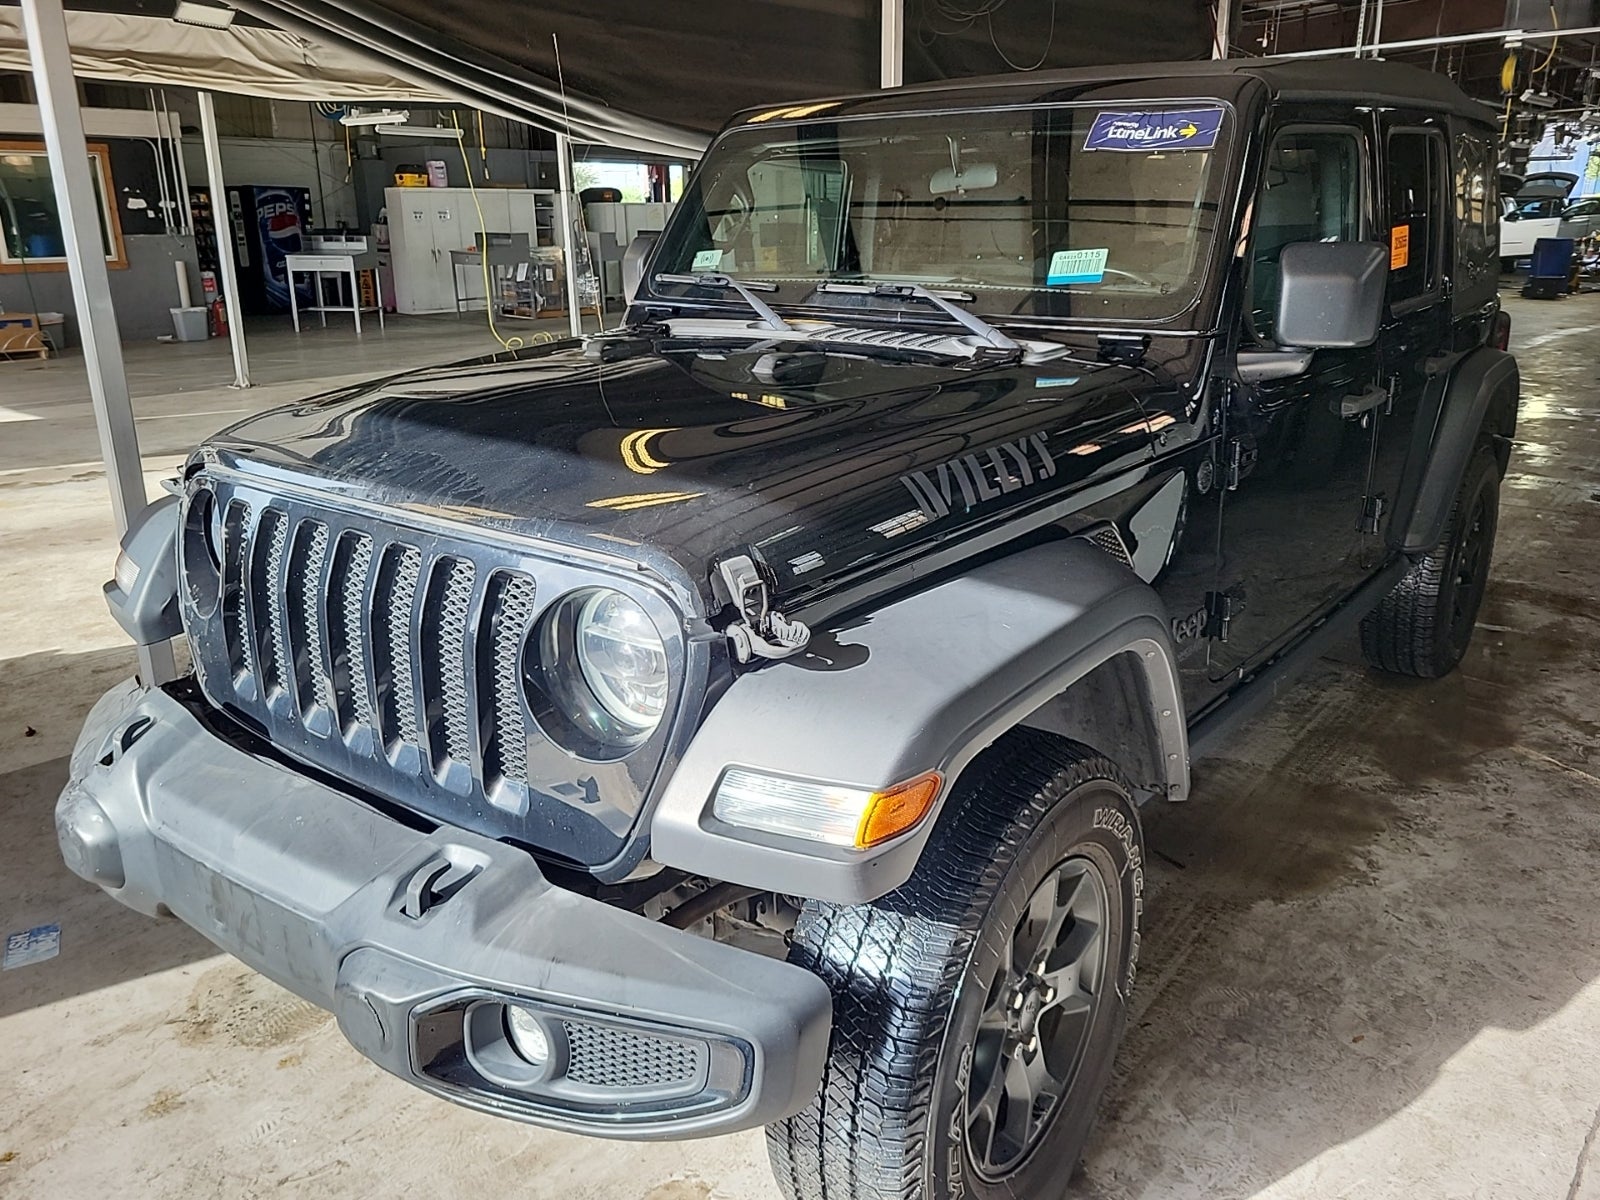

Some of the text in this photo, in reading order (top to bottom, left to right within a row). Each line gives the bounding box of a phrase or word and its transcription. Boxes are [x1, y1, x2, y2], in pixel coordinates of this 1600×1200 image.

[1107, 126, 1178, 140] LaneLink
[256, 203, 296, 223] PEPS
[899, 431, 1056, 521] WILLYS
[1093, 807, 1144, 998] WRANGLER
